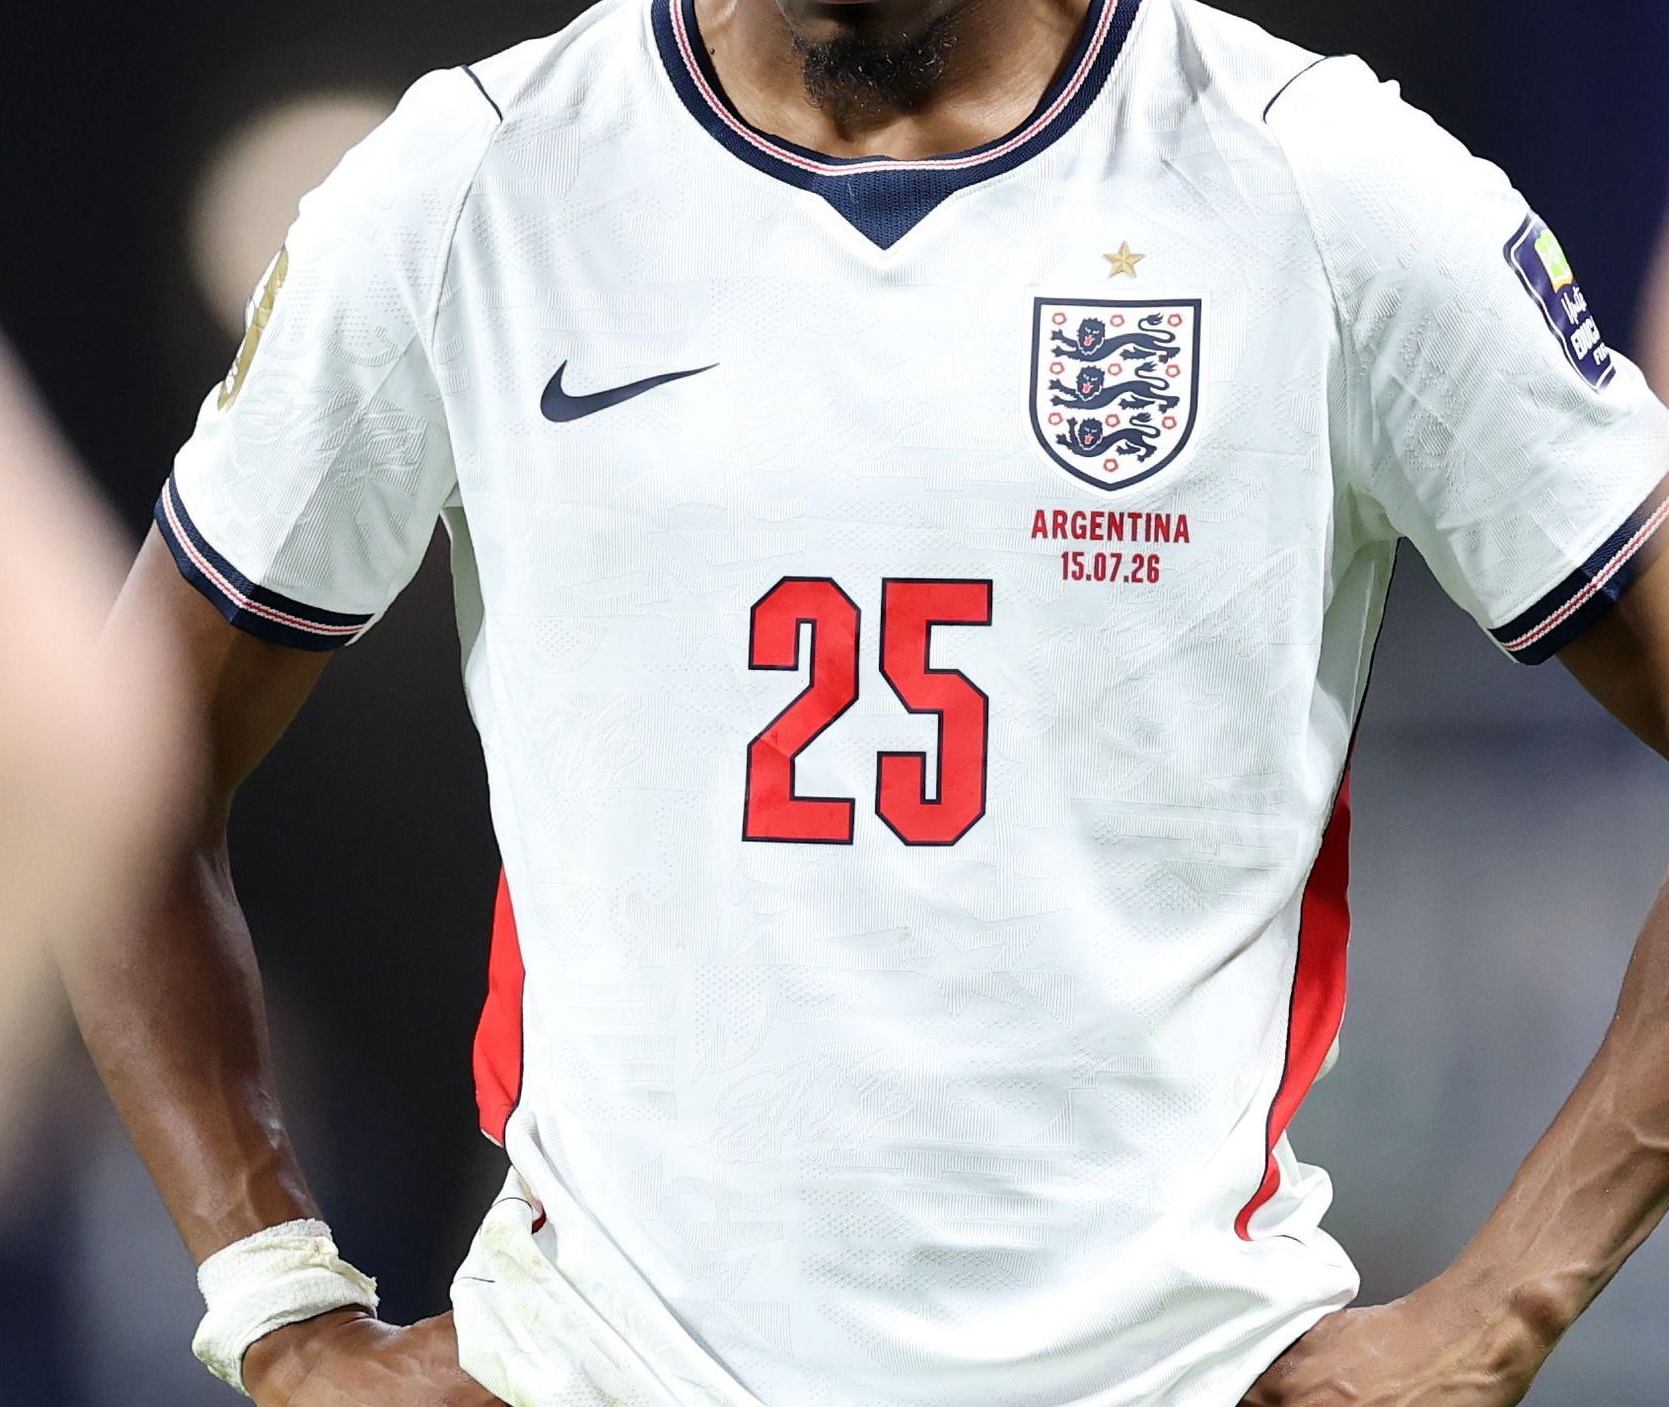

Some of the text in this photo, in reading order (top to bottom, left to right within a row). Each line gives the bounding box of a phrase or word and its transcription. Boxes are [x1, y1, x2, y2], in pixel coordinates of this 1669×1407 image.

[1031, 509, 1190, 541] ARGENTINA
[1061, 552, 1160, 584] 15.07.26
[742, 576, 994, 847] 25
